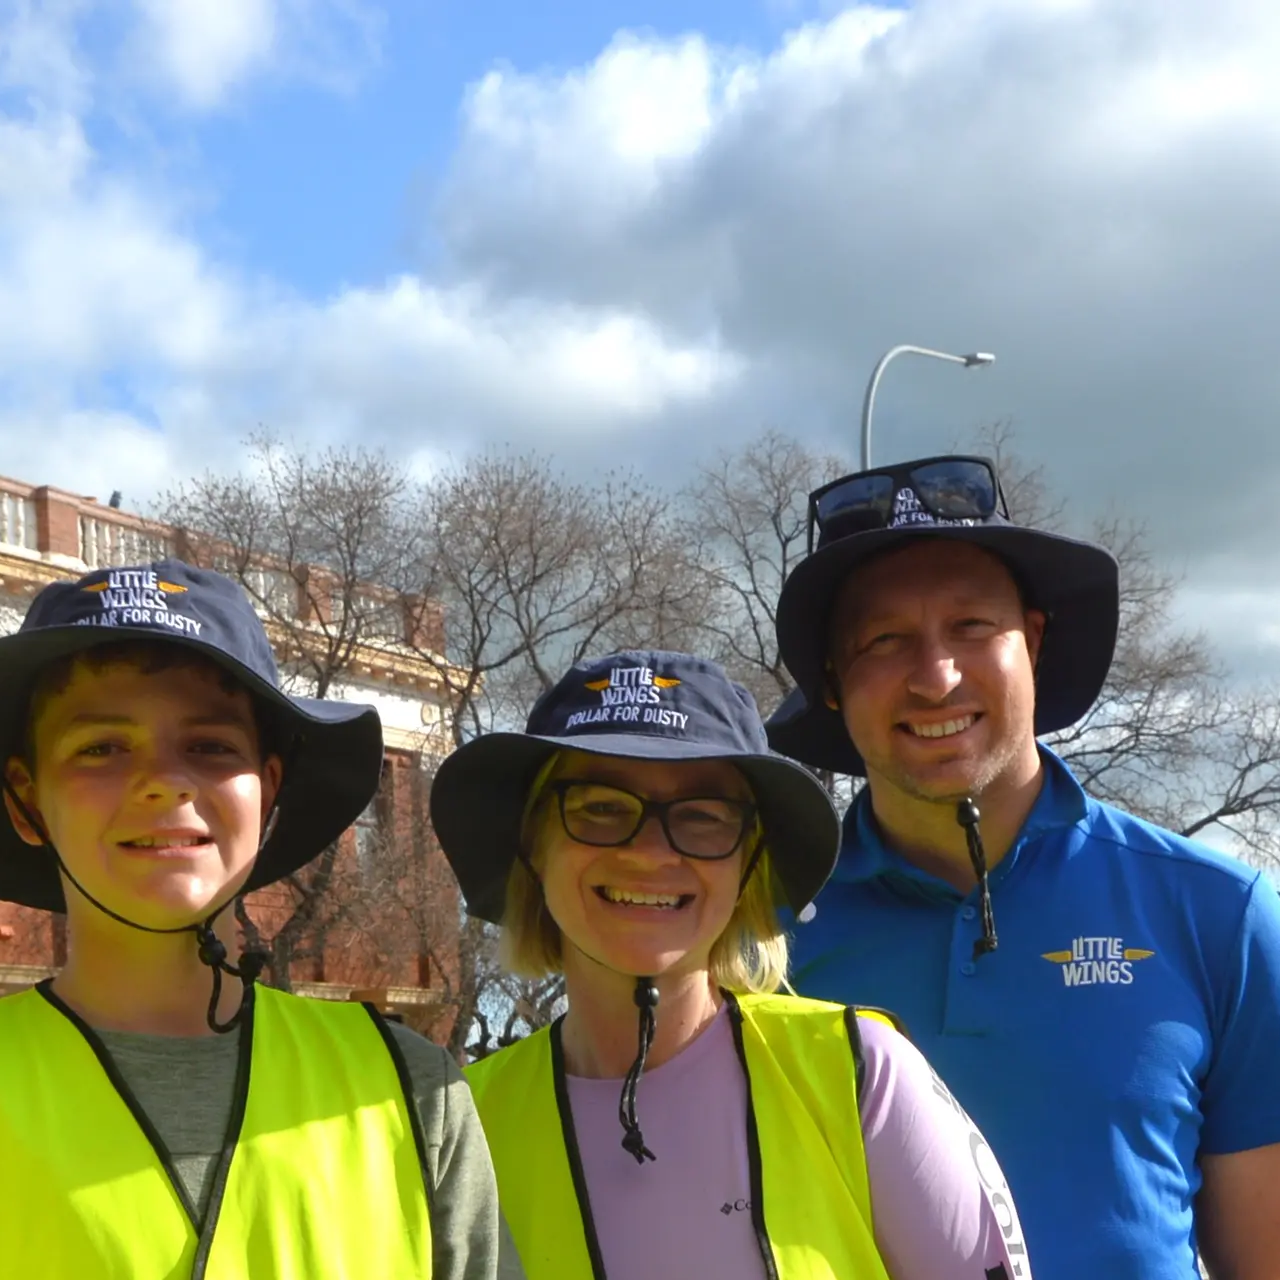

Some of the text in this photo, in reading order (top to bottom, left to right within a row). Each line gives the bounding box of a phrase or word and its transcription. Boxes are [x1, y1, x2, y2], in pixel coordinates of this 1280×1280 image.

[108, 570, 158, 590] LITTLE
[99, 588, 168, 611] WINGS
[73, 611, 119, 626] OLLAR
[122, 608, 151, 624] FOR
[609, 665, 655, 688] LITTLE
[601, 686, 660, 706] WINGS
[566, 706, 689, 730] DOLLAR FOR DUSTY
[1072, 936, 1124, 961] LITTLE
[1062, 960, 1134, 987] WINGS
